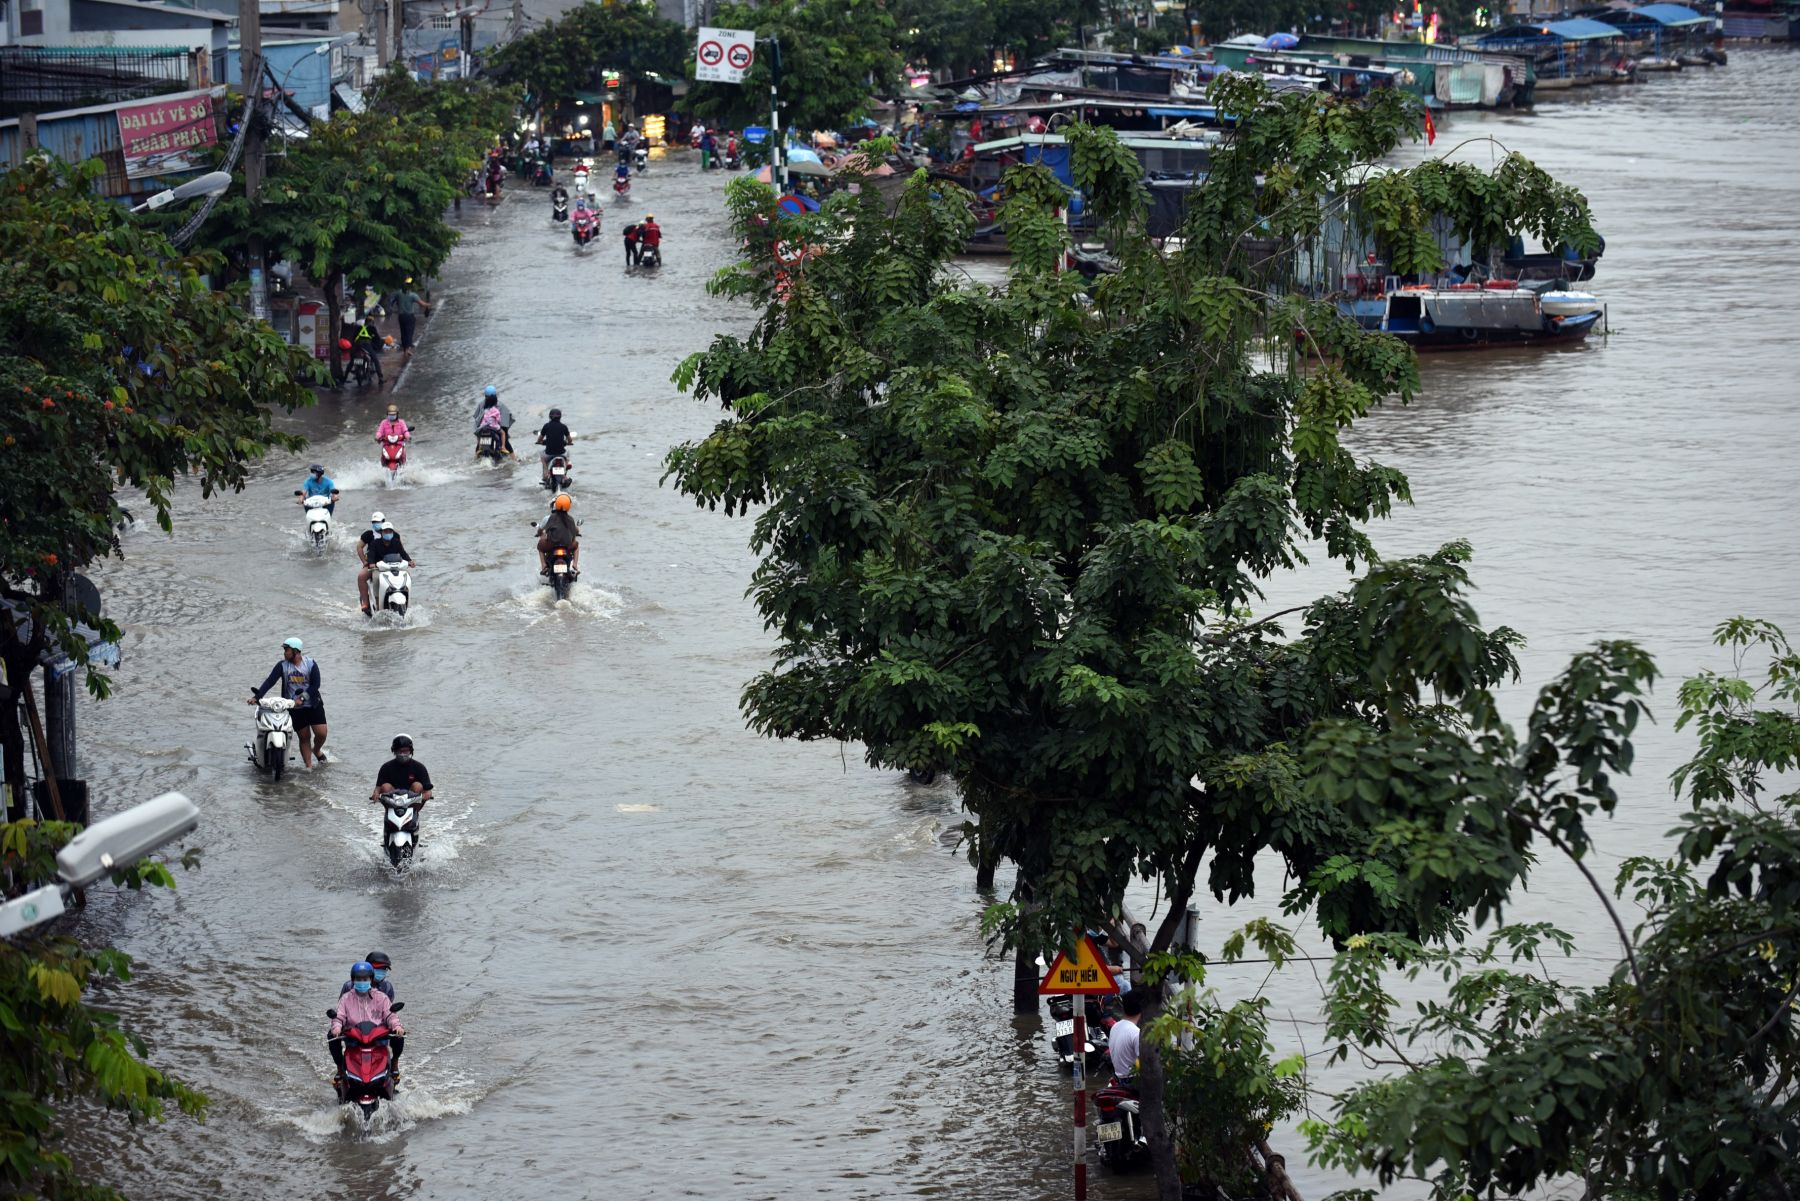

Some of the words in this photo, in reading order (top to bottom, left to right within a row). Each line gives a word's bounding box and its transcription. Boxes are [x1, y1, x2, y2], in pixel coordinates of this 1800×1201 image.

[718, 30, 737, 39] ZONE
[122, 113, 147, 130] ĐẠI
[149, 109, 165, 125] LÝ
[1060, 970, 1078, 983] NGUY
